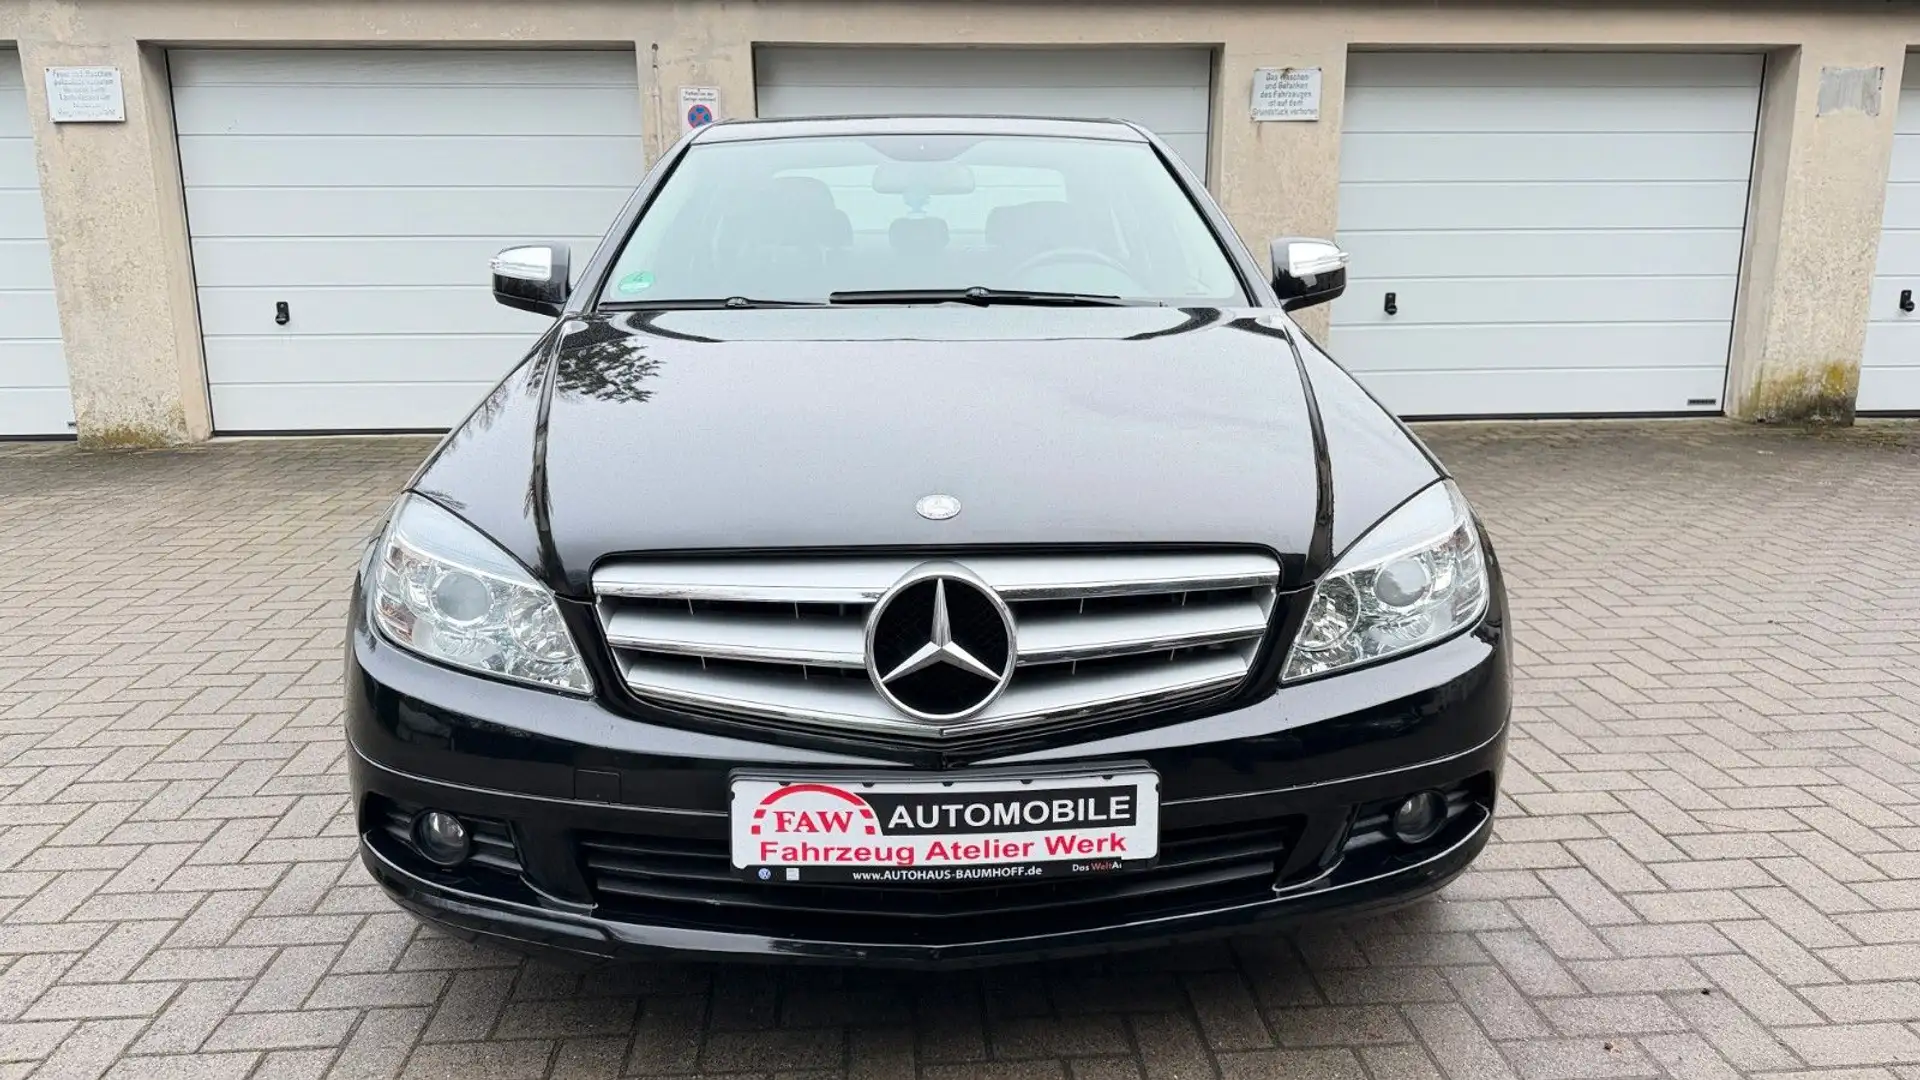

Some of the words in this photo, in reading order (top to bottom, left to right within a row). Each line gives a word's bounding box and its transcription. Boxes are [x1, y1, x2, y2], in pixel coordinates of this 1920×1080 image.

[773, 811, 854, 833] FAW
[888, 795, 1131, 829] AUTOMOBILE
[760, 841, 915, 866] Fahrzeug
[925, 838, 1035, 861] Atelier
[1045, 832, 1127, 856] Werk
[852, 865, 1043, 880] www.AUTOHAUS-BAUMHOFF.de
[1072, 863, 1090, 872] Das
